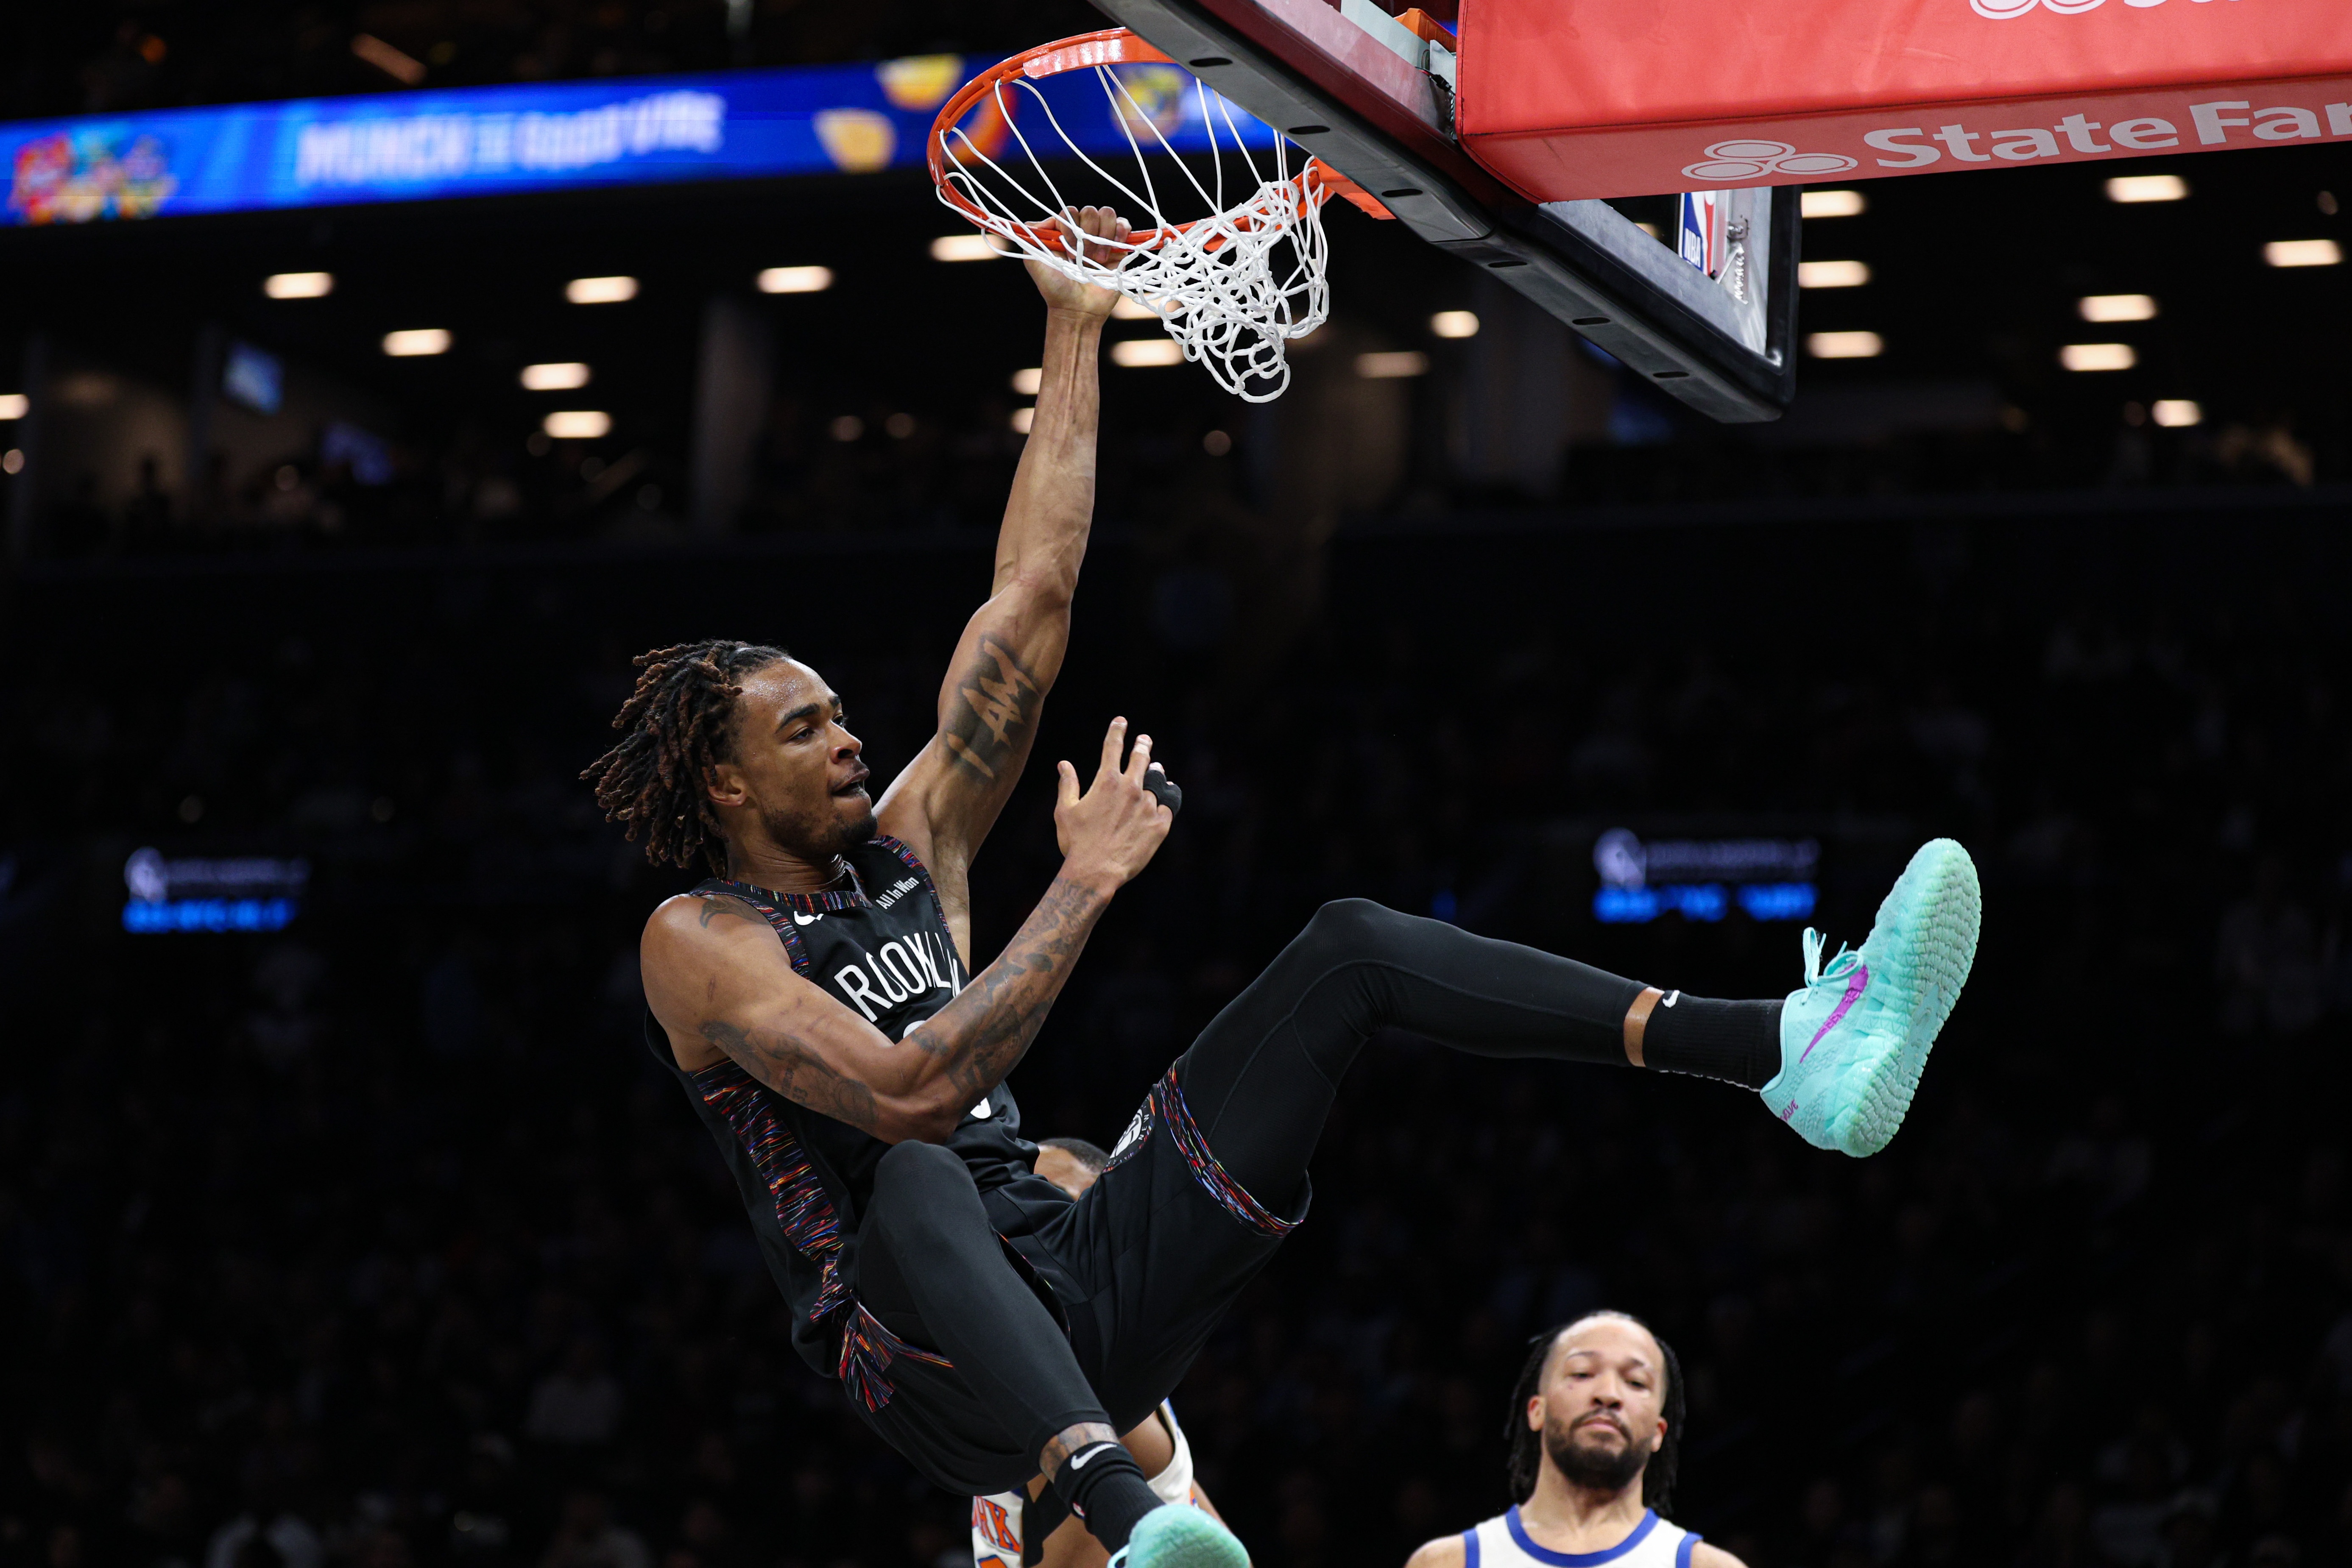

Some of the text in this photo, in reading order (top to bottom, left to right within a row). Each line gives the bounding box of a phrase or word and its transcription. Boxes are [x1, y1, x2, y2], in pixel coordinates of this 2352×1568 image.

[1864, 100, 2352, 168] State Far
[1683, 228, 1701, 268] NBA
[961, 638, 1039, 746] AM
[876, 877, 919, 909] All In Won
[834, 931, 961, 1022] ROOKLN
